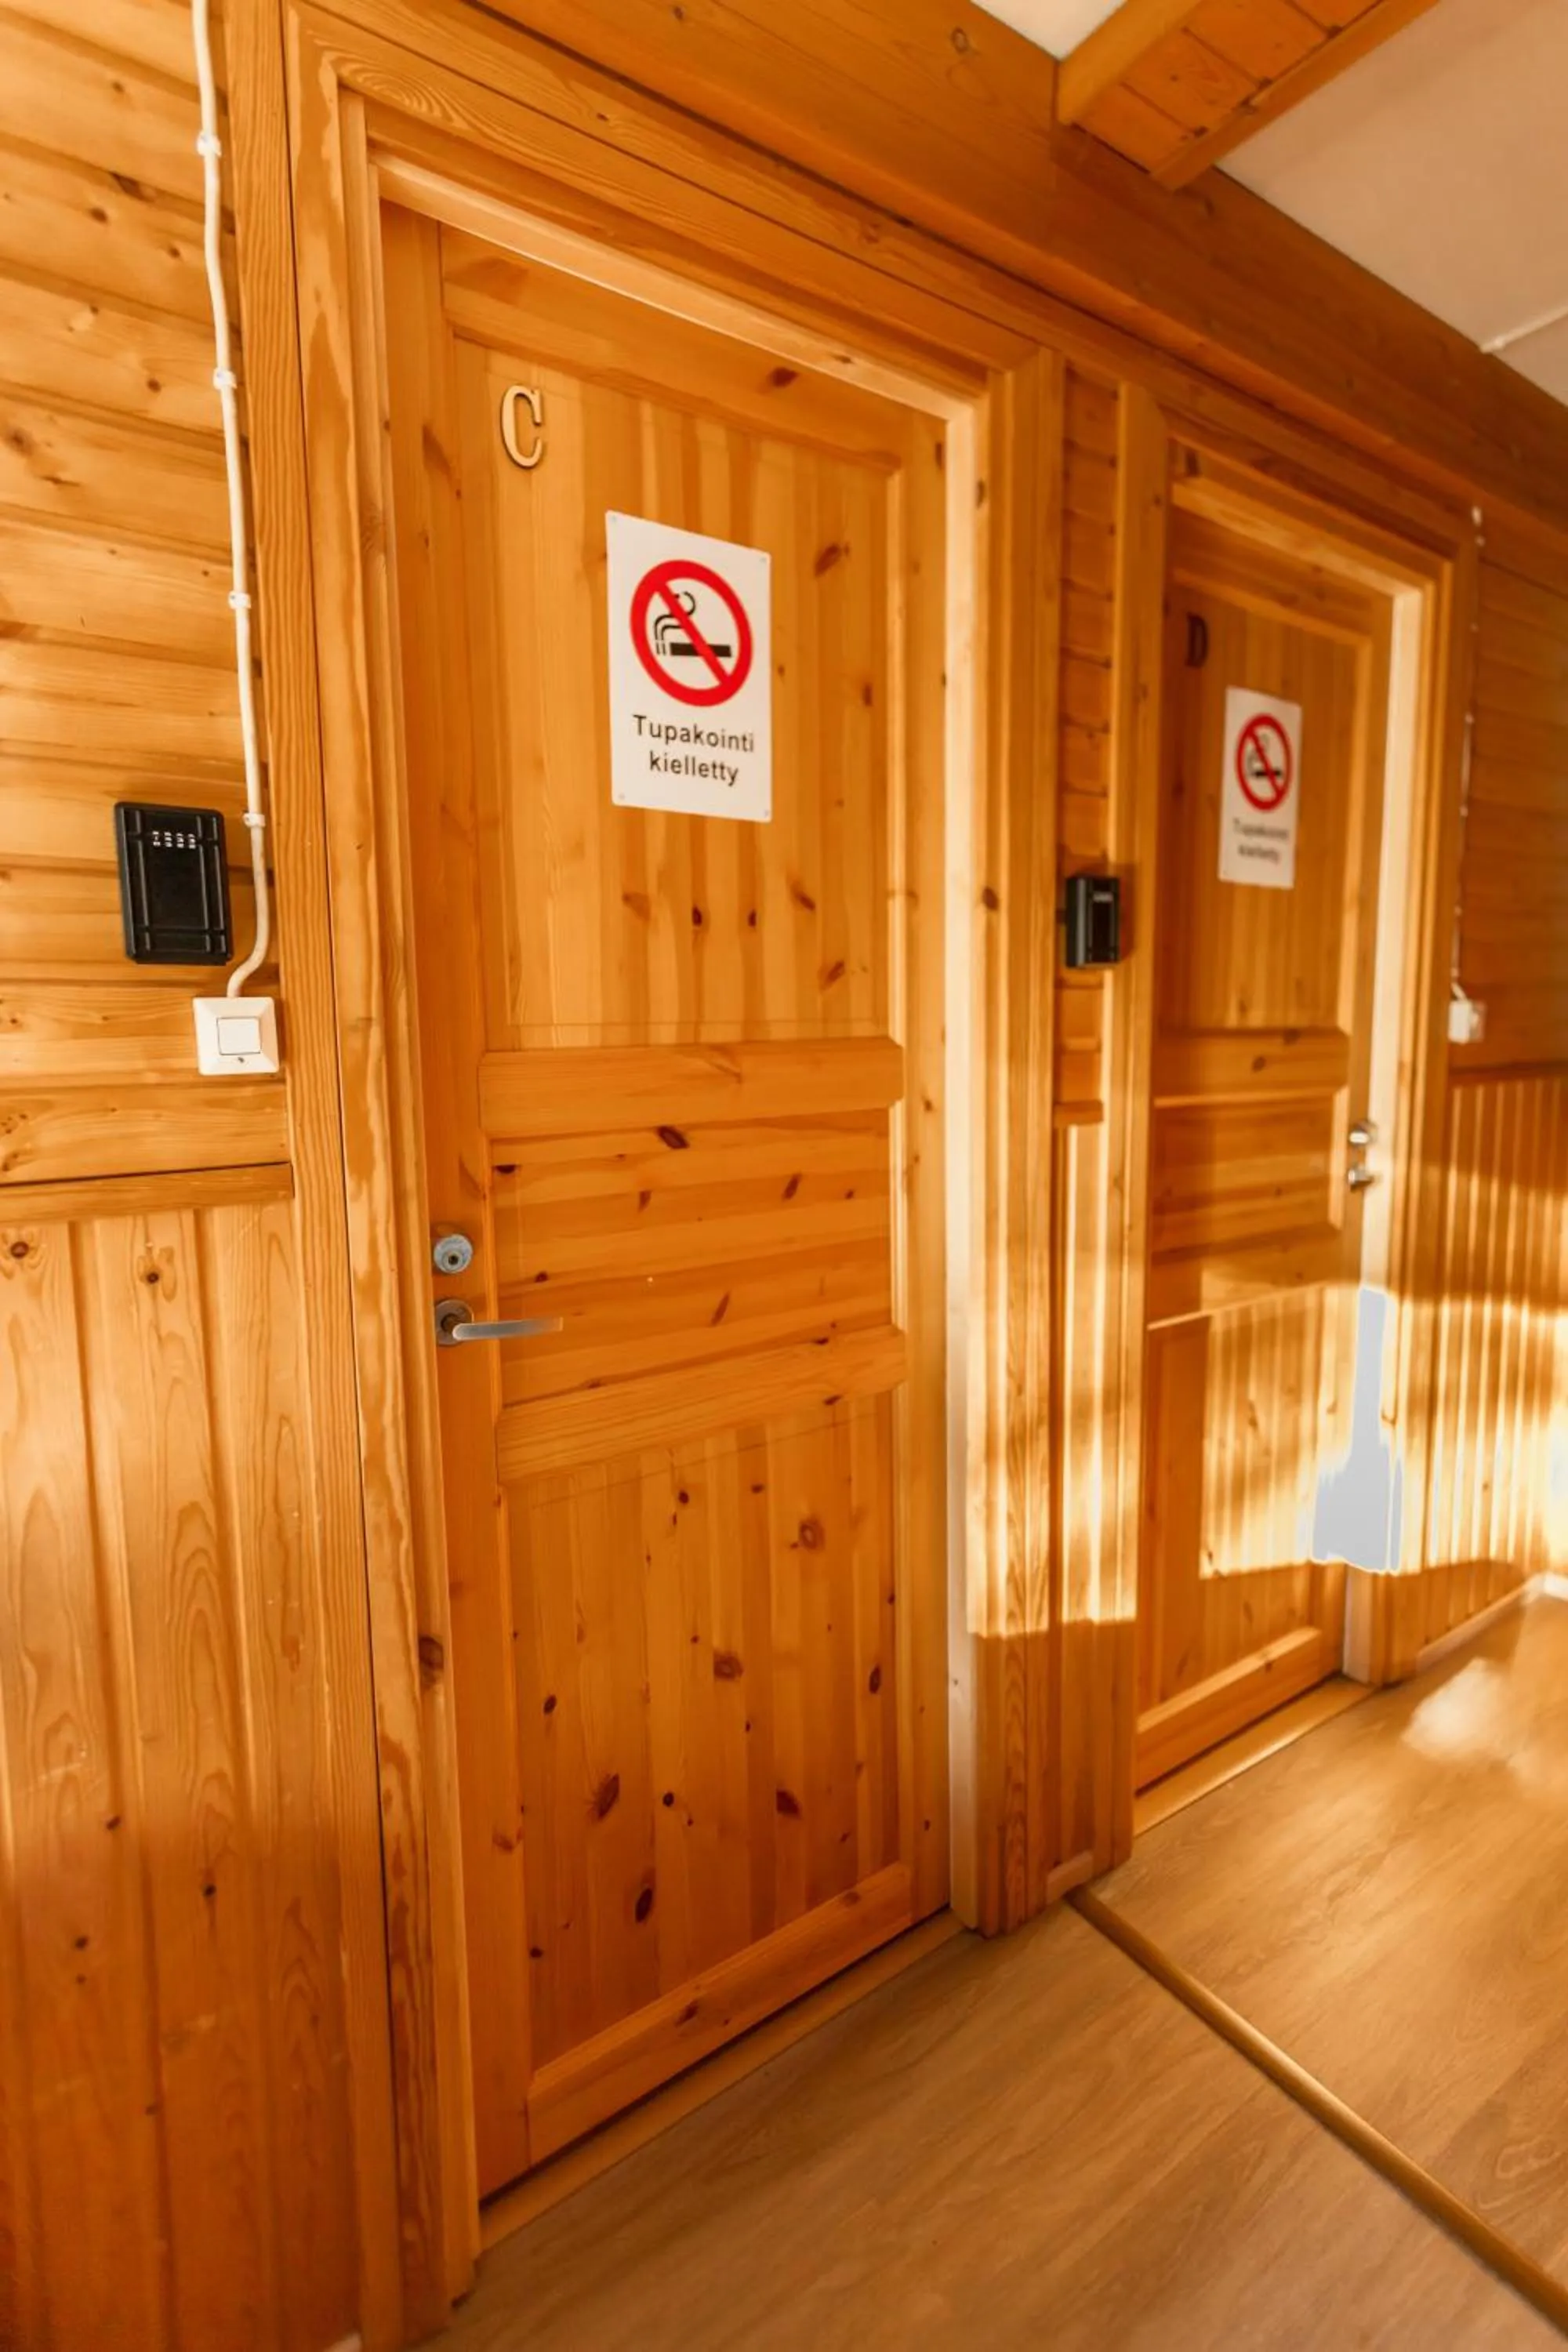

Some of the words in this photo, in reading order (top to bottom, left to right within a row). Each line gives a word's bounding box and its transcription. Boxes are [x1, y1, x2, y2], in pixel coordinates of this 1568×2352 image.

[500, 384, 543, 469] C
[632, 713, 754, 753] Tupakointi
[649, 750, 739, 787] kielletty
